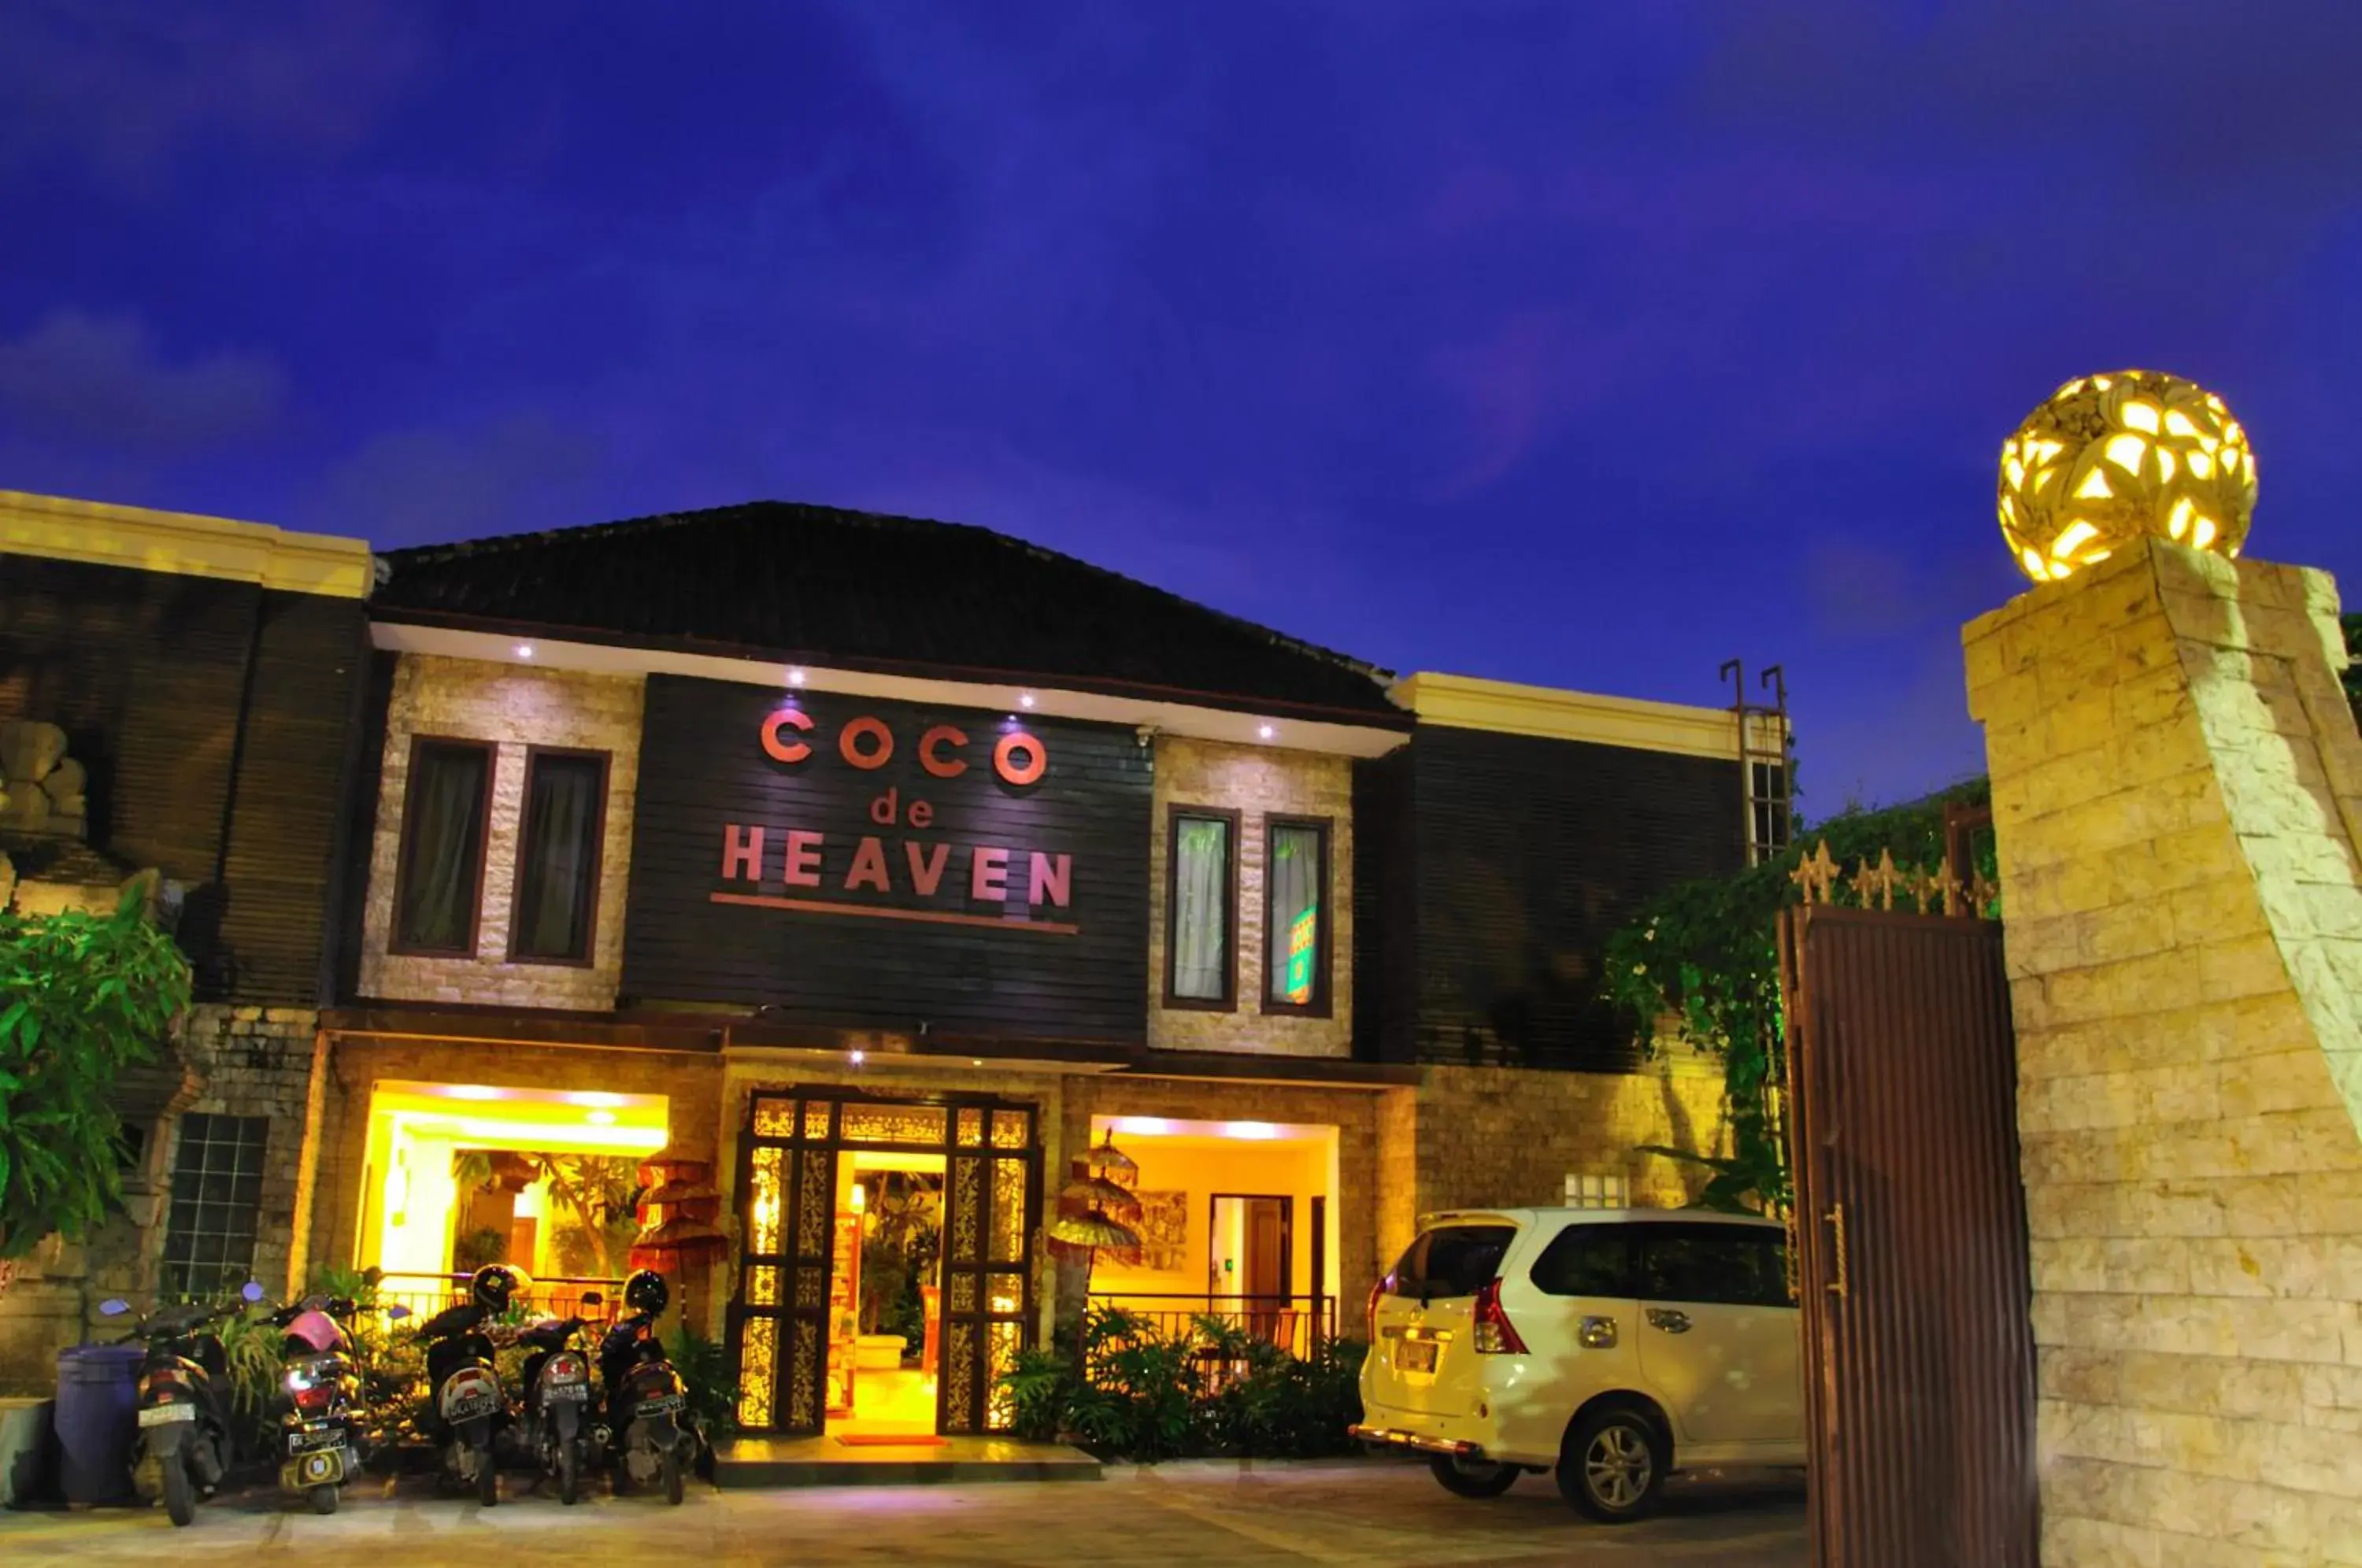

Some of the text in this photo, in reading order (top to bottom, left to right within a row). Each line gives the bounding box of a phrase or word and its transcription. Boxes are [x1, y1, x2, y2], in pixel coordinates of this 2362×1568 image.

[761, 708, 1047, 786] COCO
[871, 788, 933, 827] de
[722, 823, 1072, 907] HEAVEN
